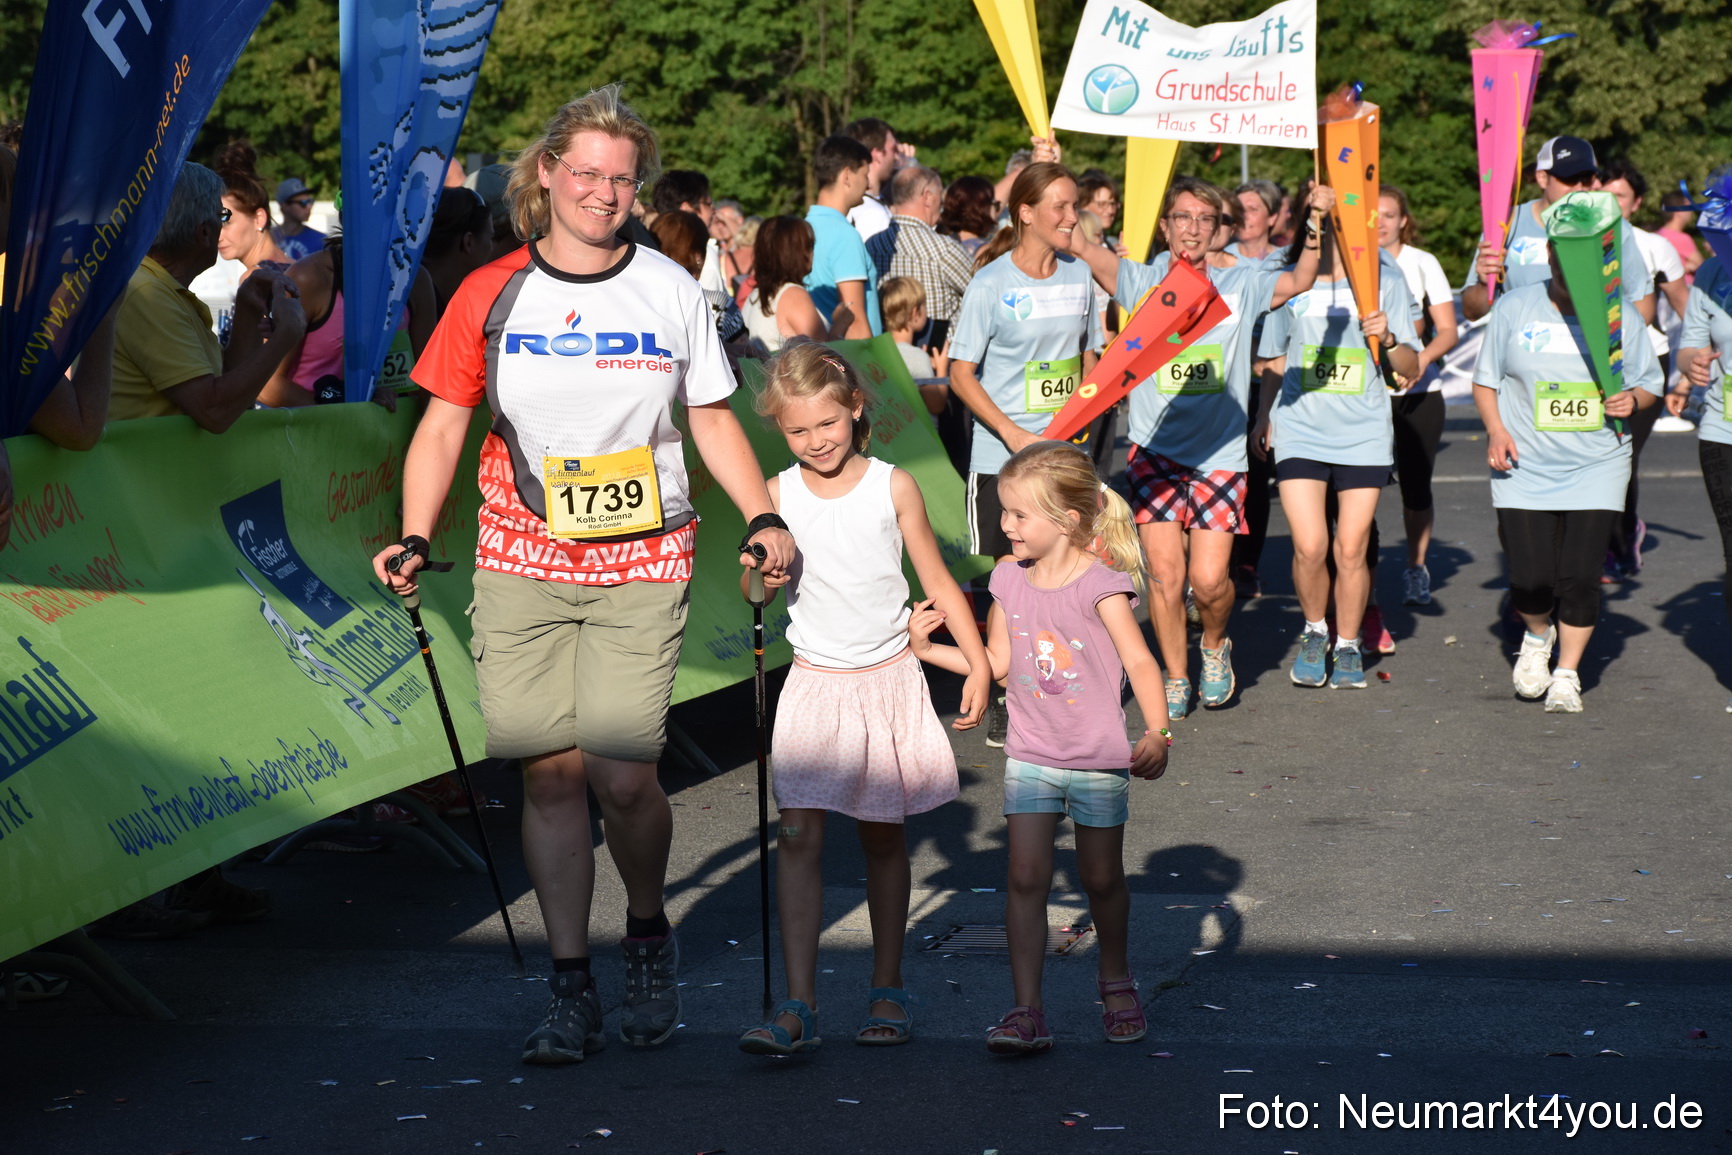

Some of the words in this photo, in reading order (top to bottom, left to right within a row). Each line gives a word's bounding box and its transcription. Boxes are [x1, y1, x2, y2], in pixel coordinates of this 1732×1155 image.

[1101, 6, 1150, 49] Mit
[1166, 47, 1213, 61] uns
[1223, 15, 1304, 58] läufts
[1155, 68, 1297, 102] Grundschule
[1156, 112, 1196, 133] Haus
[1208, 112, 1233, 135] St.
[1238, 112, 1308, 138] Marien
[19, 53, 191, 377] www.frischmann-net.de
[1602, 228, 1619, 276] HAUS
[1161, 290, 1177, 308] Q
[595, 354, 673, 374] energie
[1171, 363, 1209, 381] 649
[1315, 362, 1351, 381] 647
[1041, 376, 1074, 398] 640
[1550, 399, 1589, 417] 646
[551, 480, 581, 489] walken
[557, 469, 596, 478] firmenlauf
[559, 480, 644, 515] 1739
[576, 514, 597, 524] Kolb
[598, 512, 633, 523] Corinna
[250, 537, 288, 569] Fischer
[507, 537, 574, 568] AVIA
[581, 541, 652, 568] AVIA
[626, 554, 688, 580] AVIA
[386, 670, 429, 714] neumarkt
[107, 727, 349, 857] www.firmenlauf-oberpfalz.de
